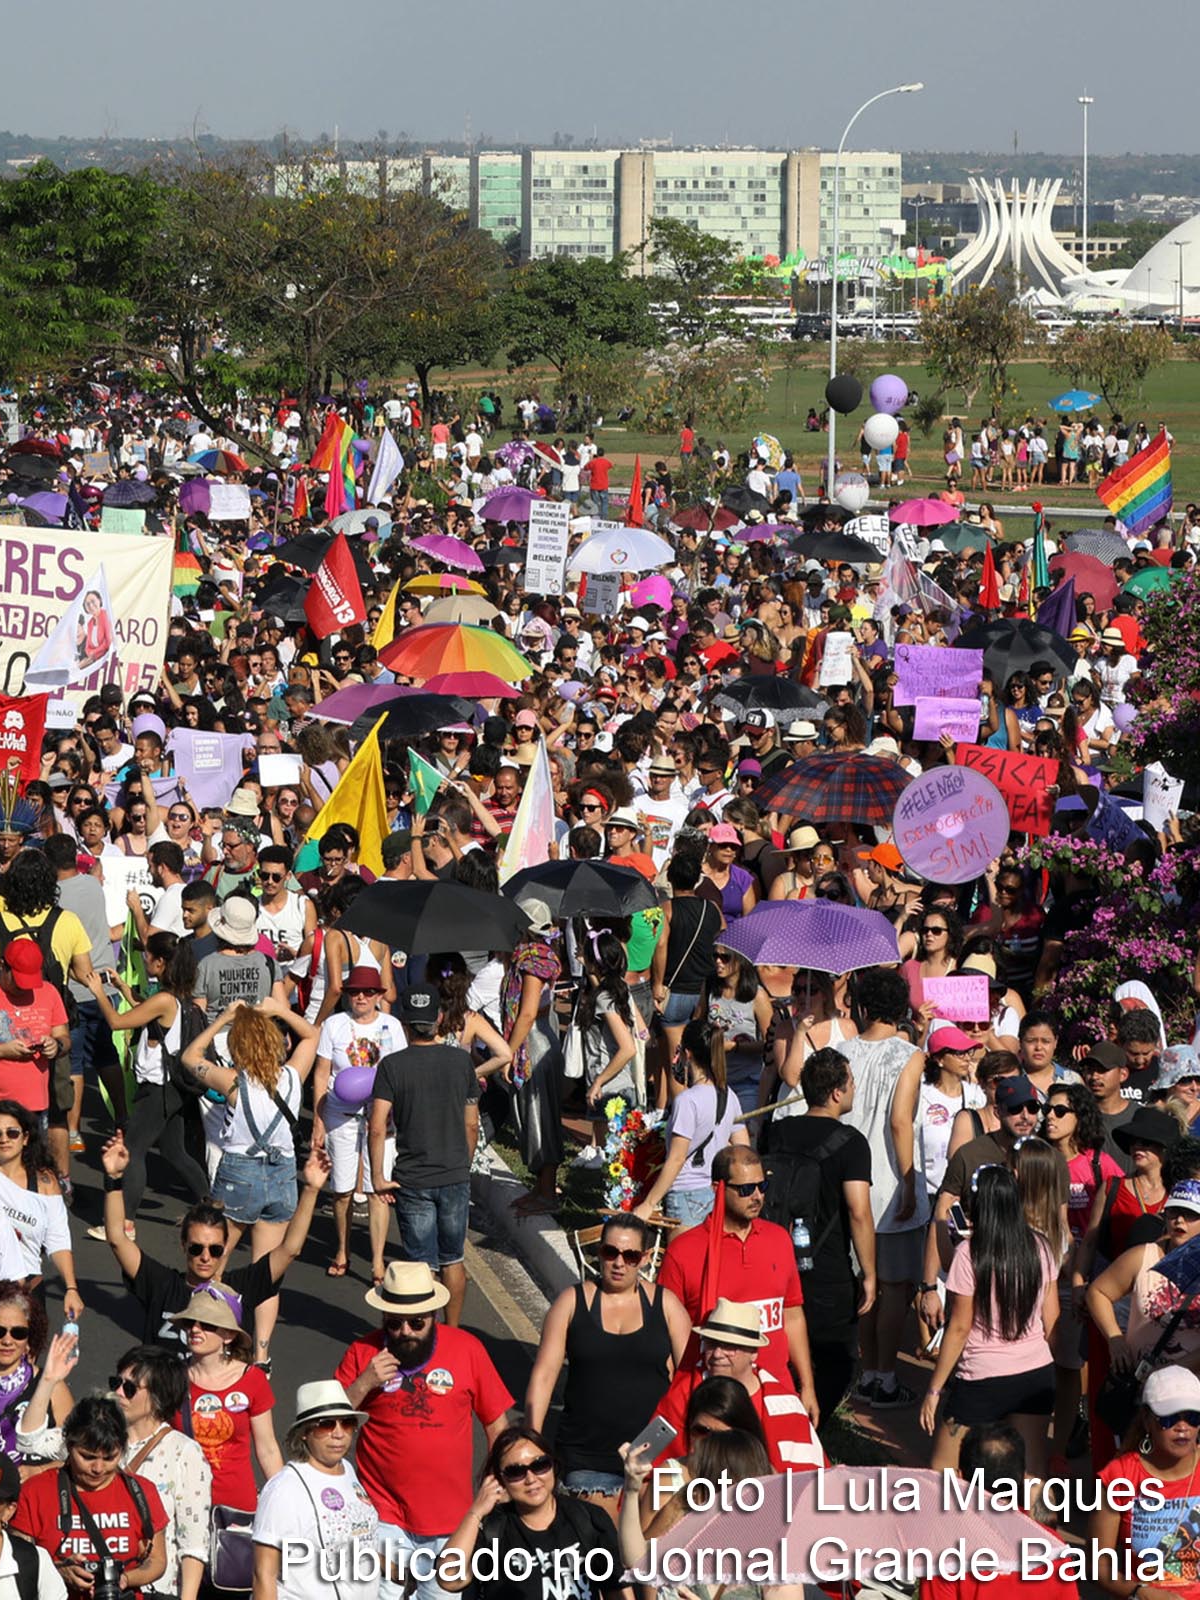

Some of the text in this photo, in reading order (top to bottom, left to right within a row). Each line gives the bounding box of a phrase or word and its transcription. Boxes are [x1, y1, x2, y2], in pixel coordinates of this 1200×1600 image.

[845, 516, 889, 535] #ELE
[332, 600, 356, 625] 13
[30, 615, 158, 648] BOARO
[899, 781, 938, 821] #ELE
[218, 966, 261, 981] MULHERES
[219, 981, 259, 995] CONTRA
[1119, 1085, 1144, 1100] ute
[763, 1300, 781, 1329] 13
[58, 1512, 130, 1530] EME
[61, 1536, 130, 1554] FIECE
